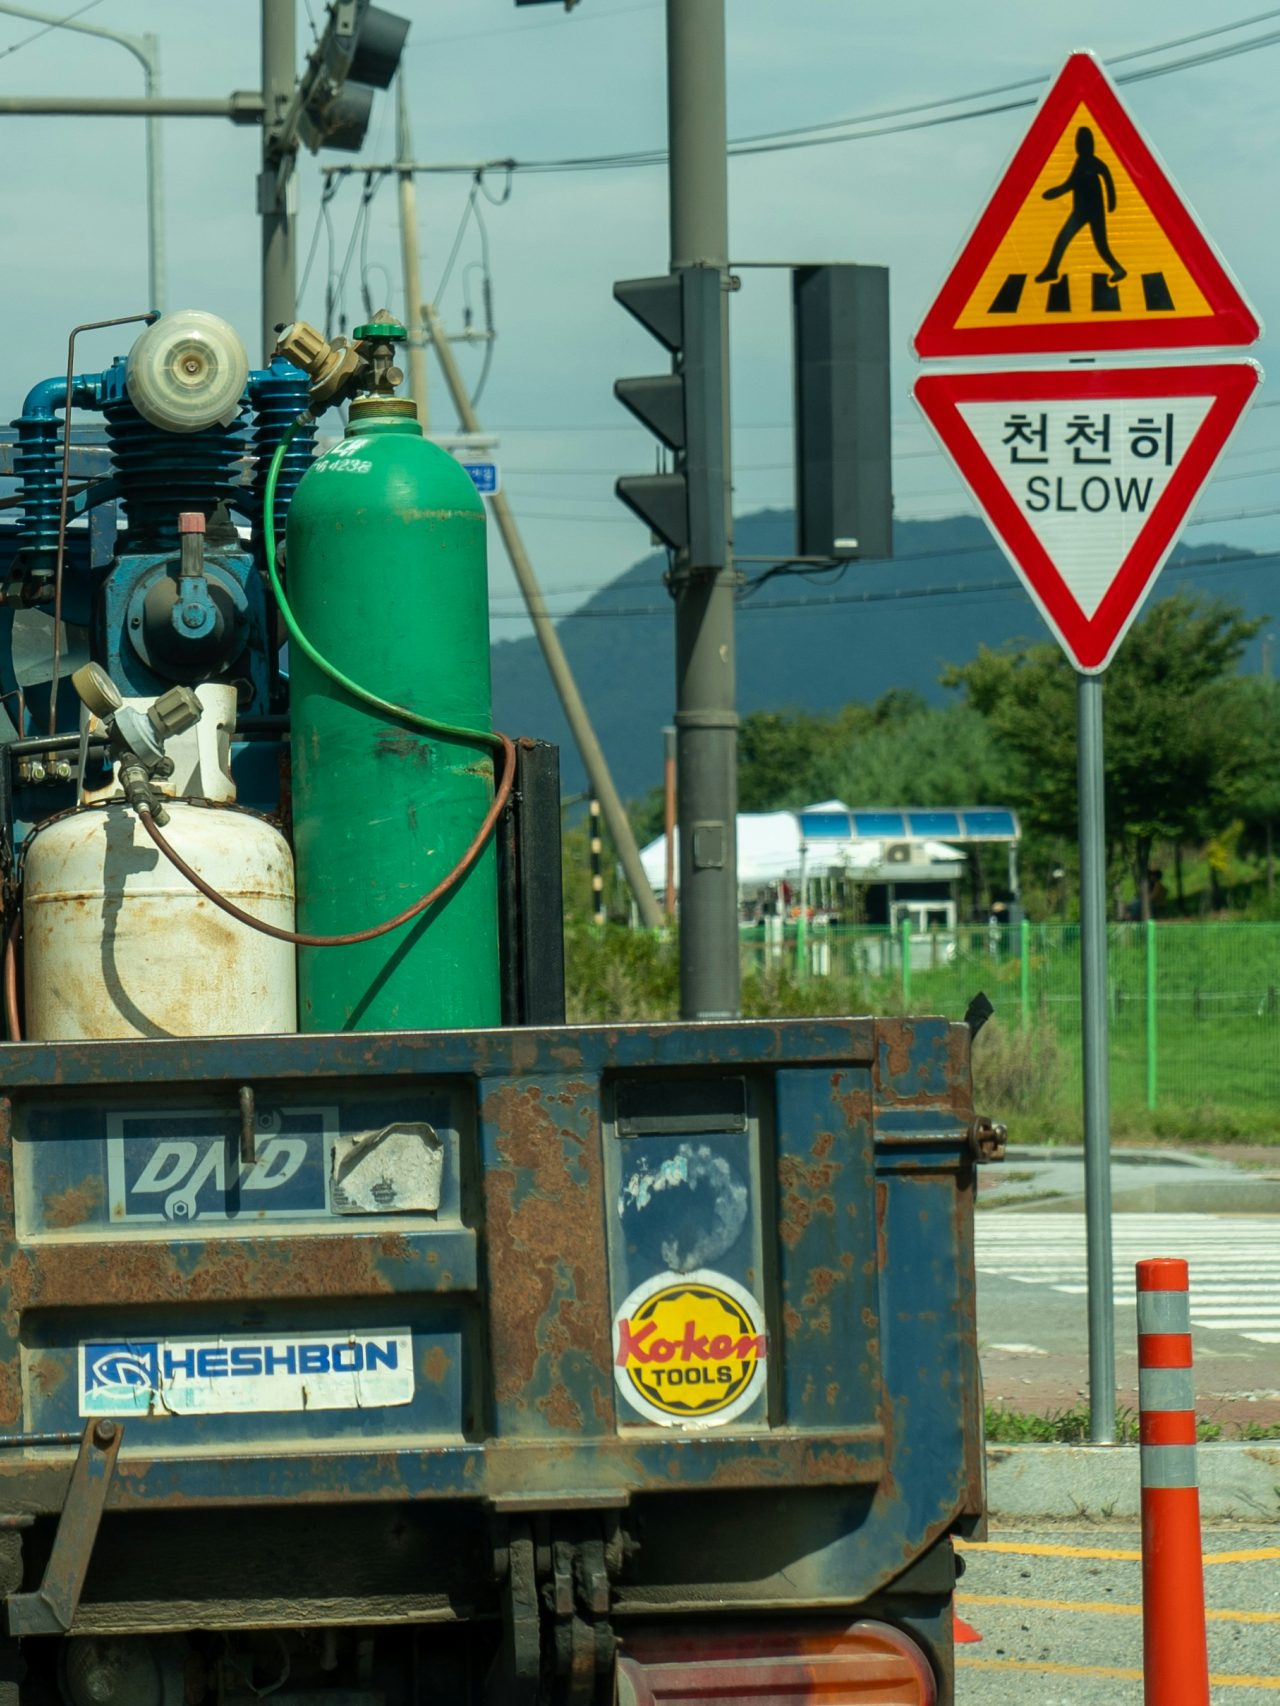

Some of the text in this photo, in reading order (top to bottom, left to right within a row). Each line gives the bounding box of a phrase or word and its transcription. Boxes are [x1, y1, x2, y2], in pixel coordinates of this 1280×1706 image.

[1002, 413, 1174, 466] 천천히
[1025, 476, 1154, 513] SLOW
[163, 1340, 399, 1379] HESHBON
[651, 1366, 733, 1387] TOOLS
